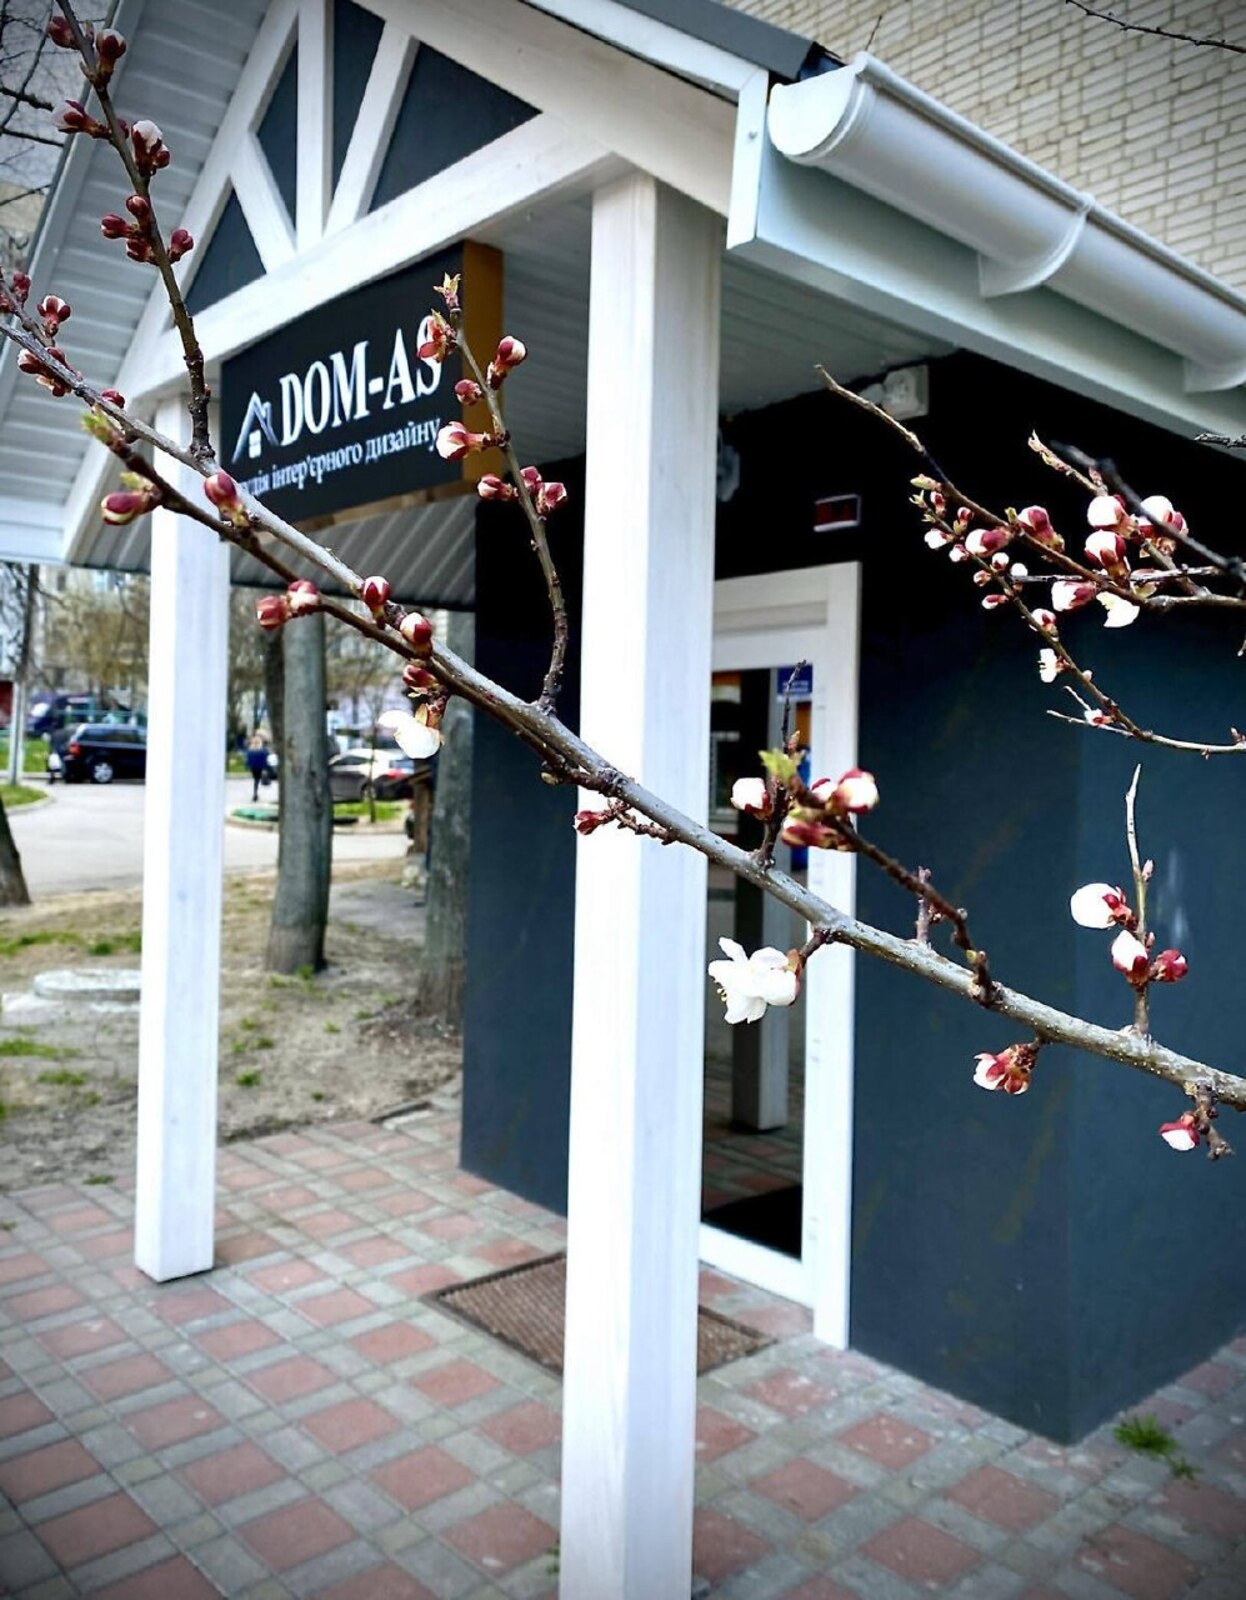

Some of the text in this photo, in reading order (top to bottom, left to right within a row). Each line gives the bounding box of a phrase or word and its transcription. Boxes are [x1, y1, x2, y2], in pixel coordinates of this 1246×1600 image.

[279, 315, 442, 446] DOM-AS
[271, 441, 363, 490] інтер'єрного
[365, 417, 441, 463] дизайну
